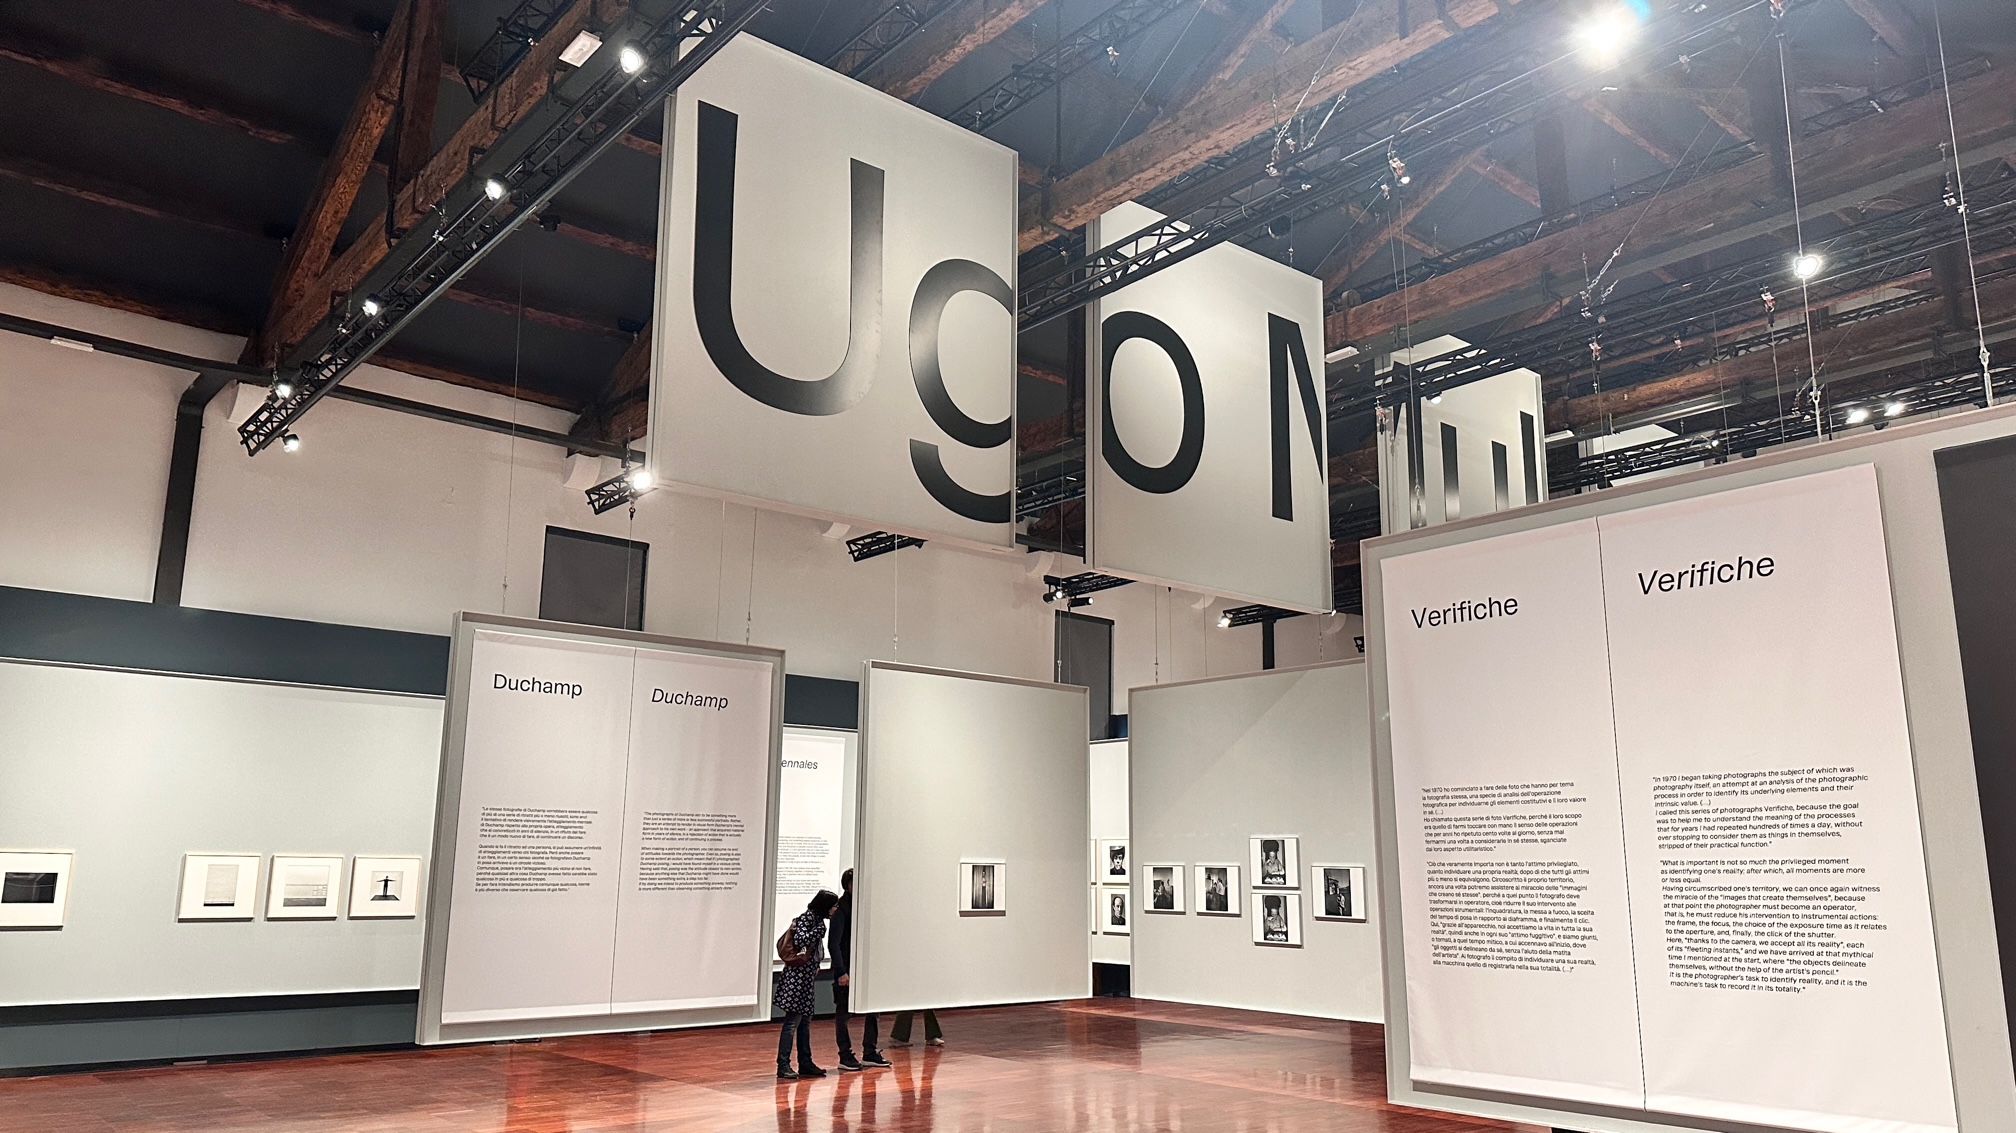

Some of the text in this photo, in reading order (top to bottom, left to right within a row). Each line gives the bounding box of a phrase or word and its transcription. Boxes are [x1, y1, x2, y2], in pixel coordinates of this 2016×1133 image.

[1638, 556, 1774, 595] Verifiche
[1411, 597, 1518, 628] Verifiche
[494, 674, 582, 698] Duchamp
[652, 688, 728, 711] Duchamp
[1722, 779, 1749, 788] attempt
[1818, 775, 1868, 783] photographic
